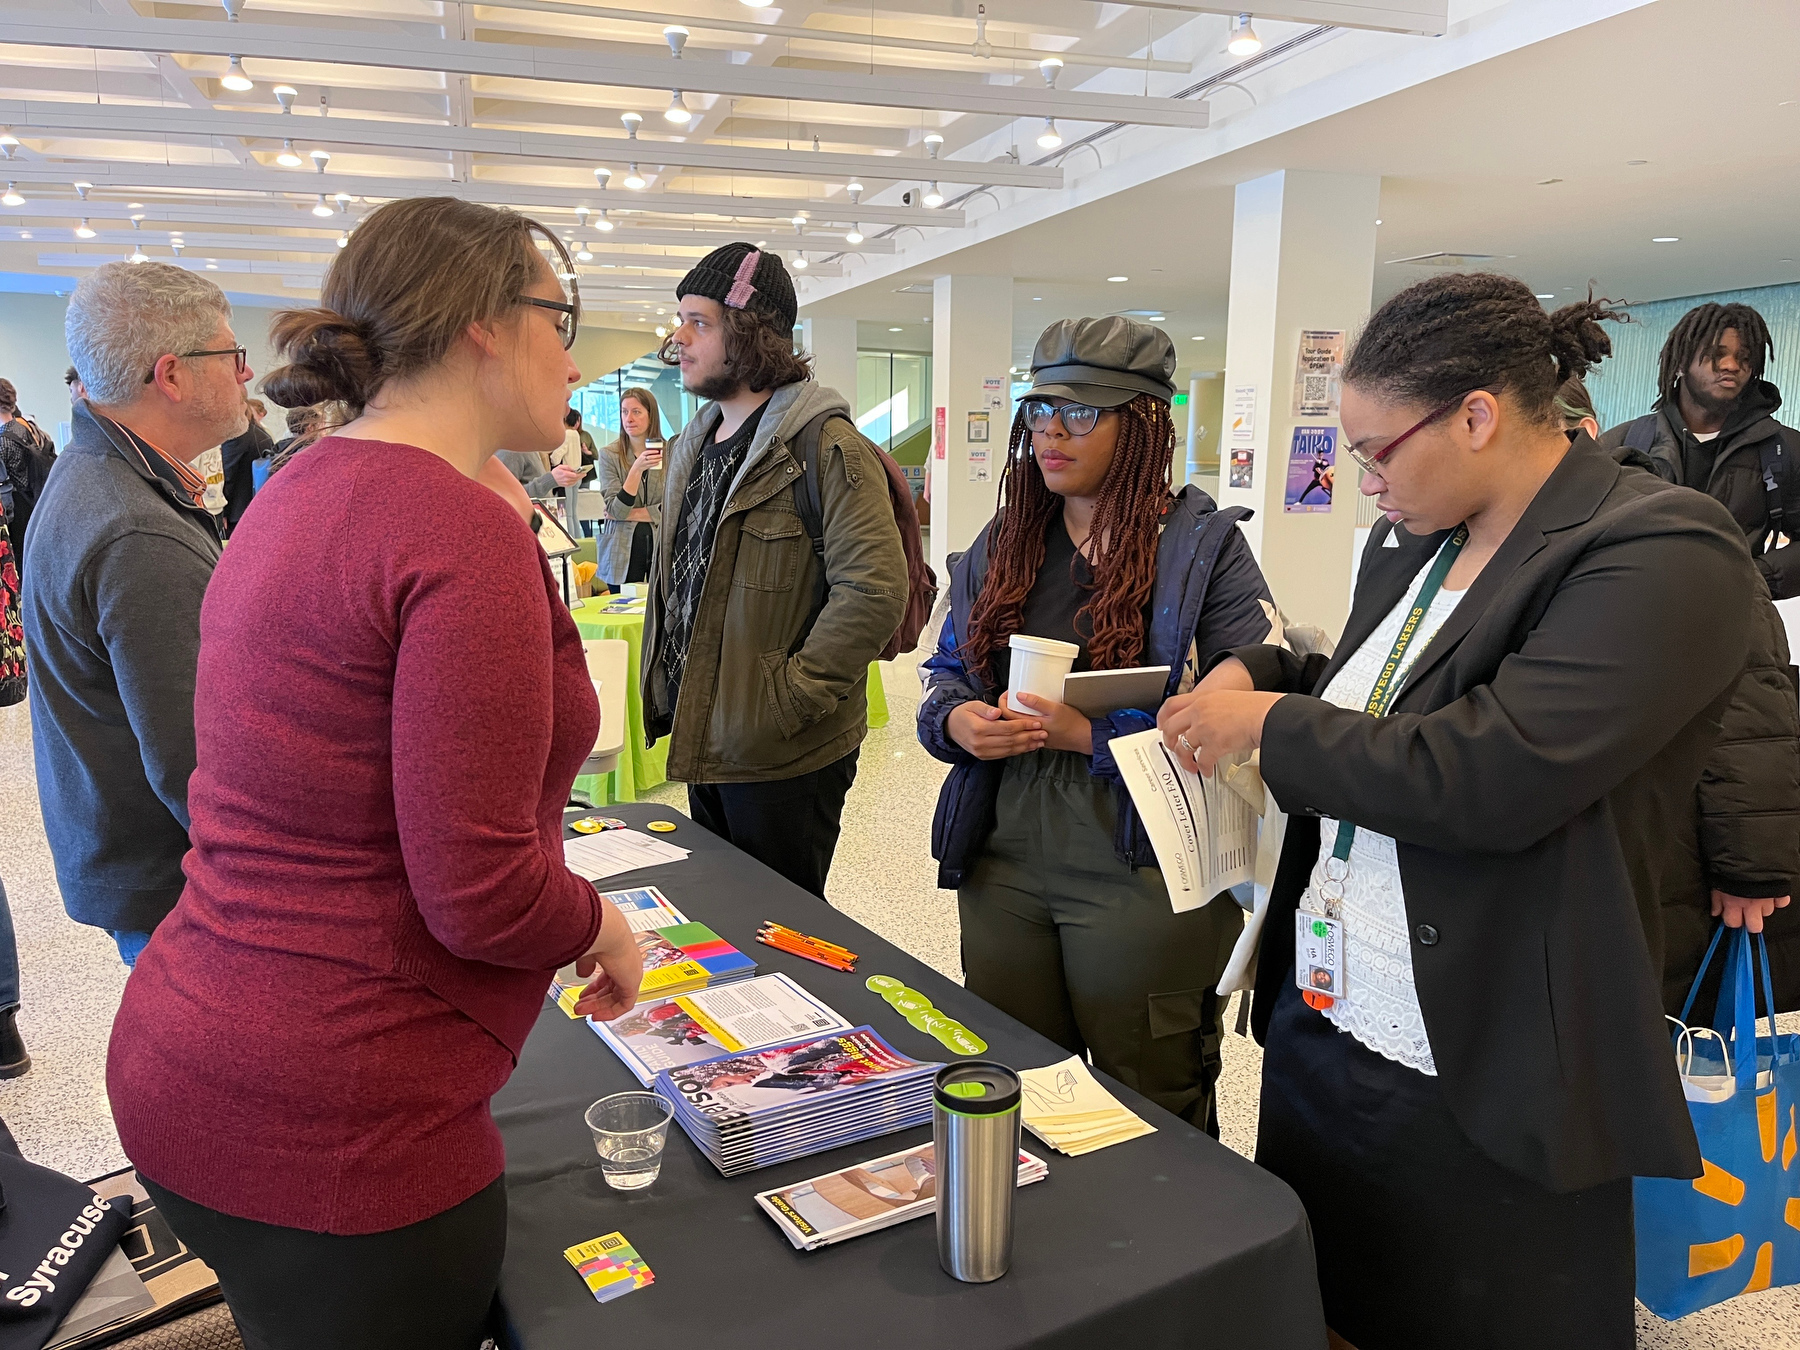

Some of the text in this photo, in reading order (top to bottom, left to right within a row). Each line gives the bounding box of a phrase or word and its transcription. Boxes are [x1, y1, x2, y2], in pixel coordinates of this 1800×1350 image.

[1293, 435, 1334, 455] TAIKO
[1390, 605, 1424, 661] LAKERS
[1142, 770, 1157, 793] Career
[1161, 772, 1195, 853] Cover Letter FAQ
[1327, 930, 1335, 966] OSWEGO
[632, 1044, 659, 1071] FAMILY
[649, 1043, 676, 1067] GUIDE
[837, 1037, 863, 1061] Biggs
[771, 1195, 789, 1213] Guide
[6, 1194, 112, 1307] Syracuse
